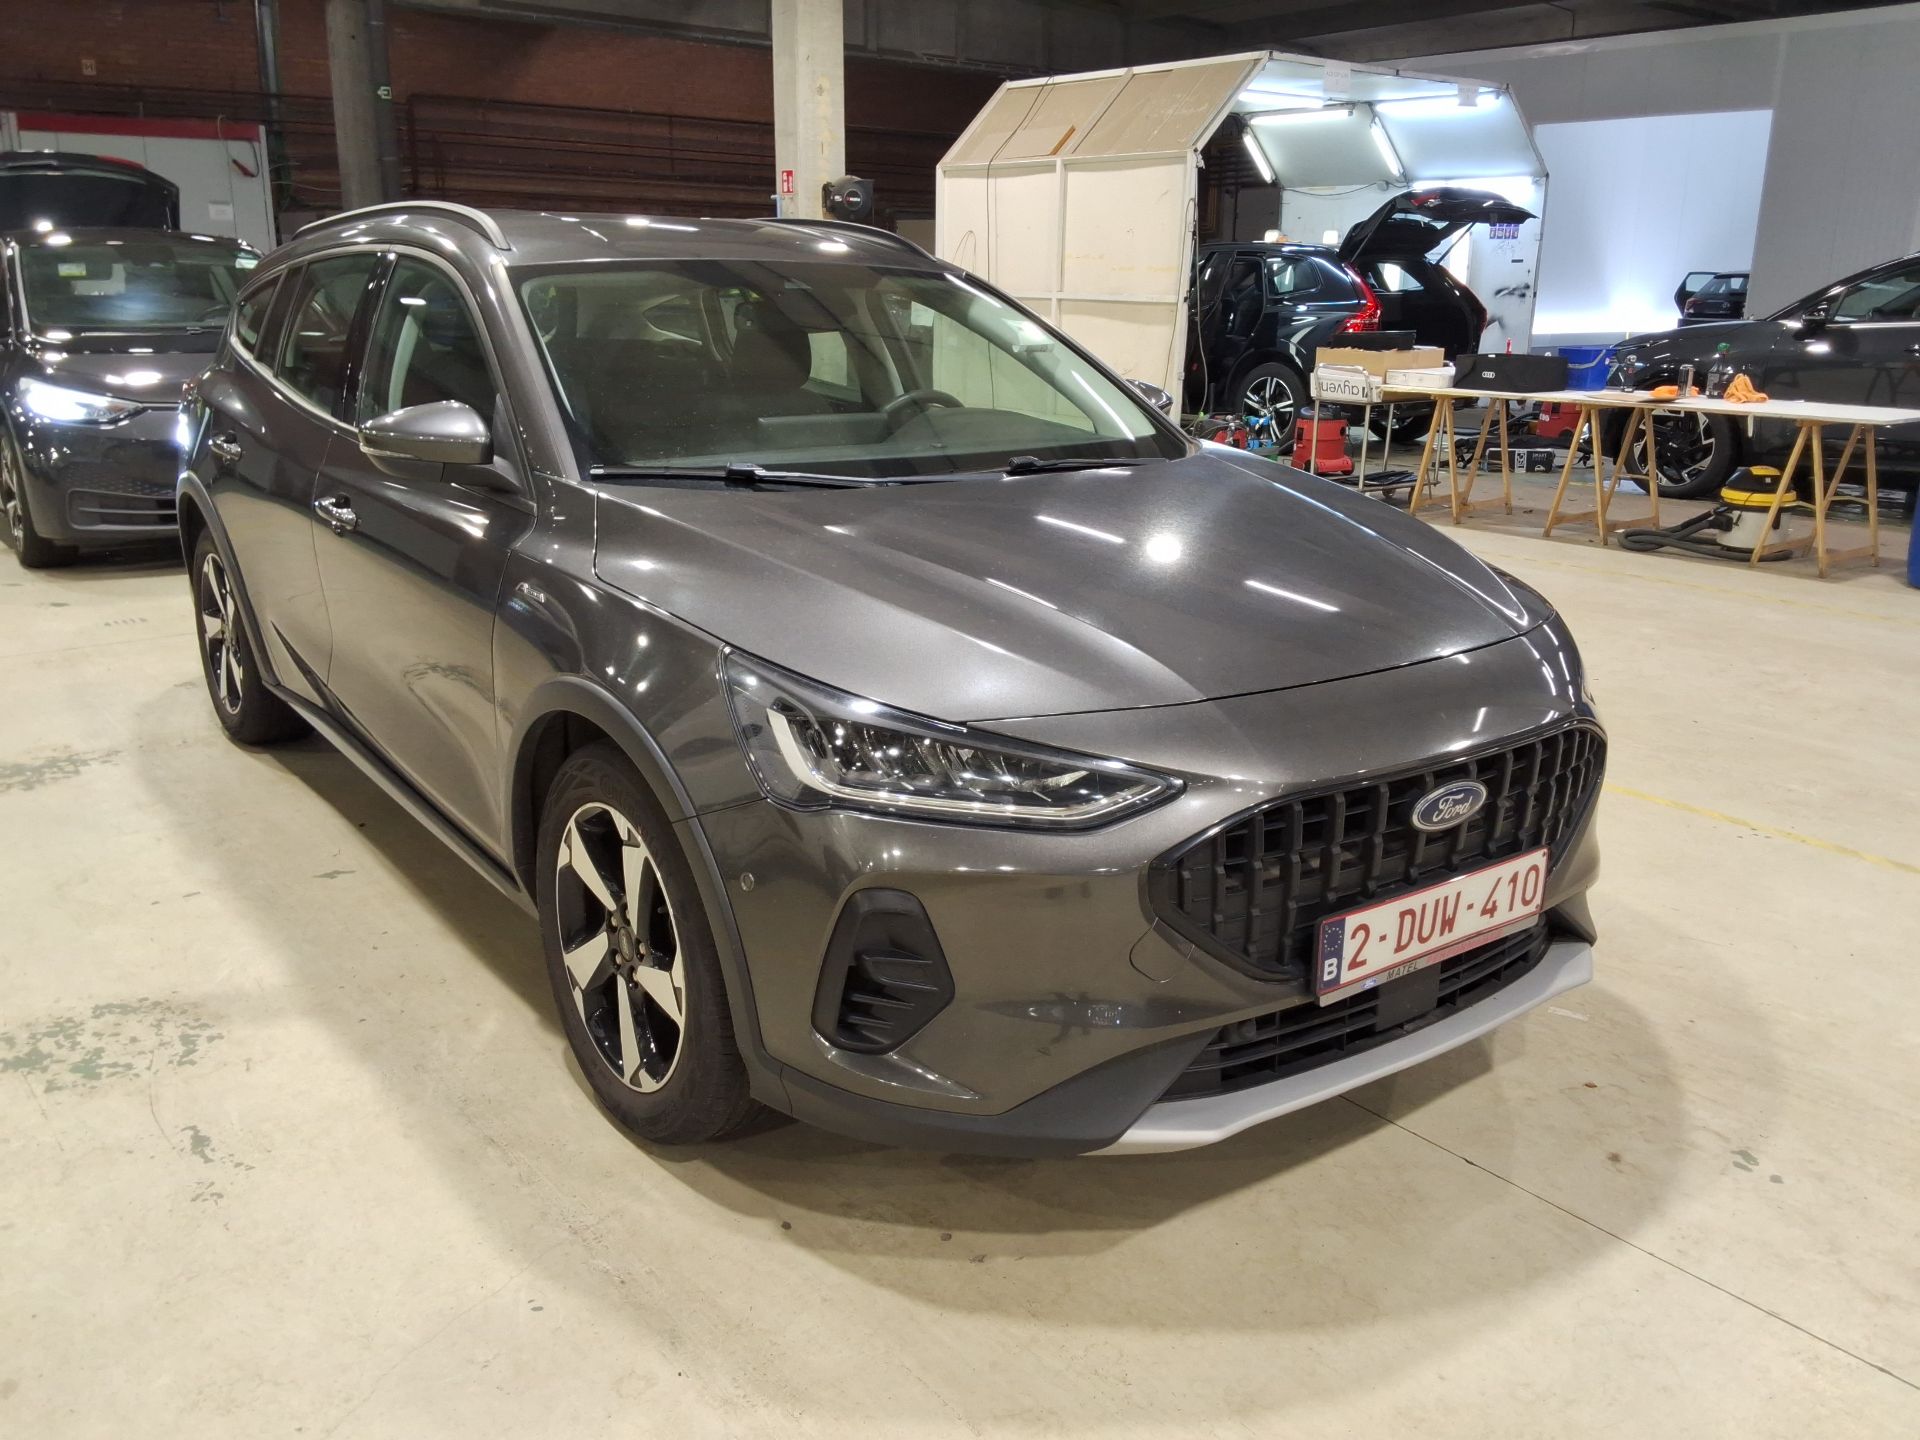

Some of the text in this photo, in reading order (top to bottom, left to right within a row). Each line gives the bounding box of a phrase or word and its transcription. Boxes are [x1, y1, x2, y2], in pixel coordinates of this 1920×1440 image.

[1317, 380, 1361, 396] ayven
[1432, 793, 1473, 822] Ford
[1347, 864, 1540, 972] 2-DUW-410
[1323, 957, 1338, 981] B
